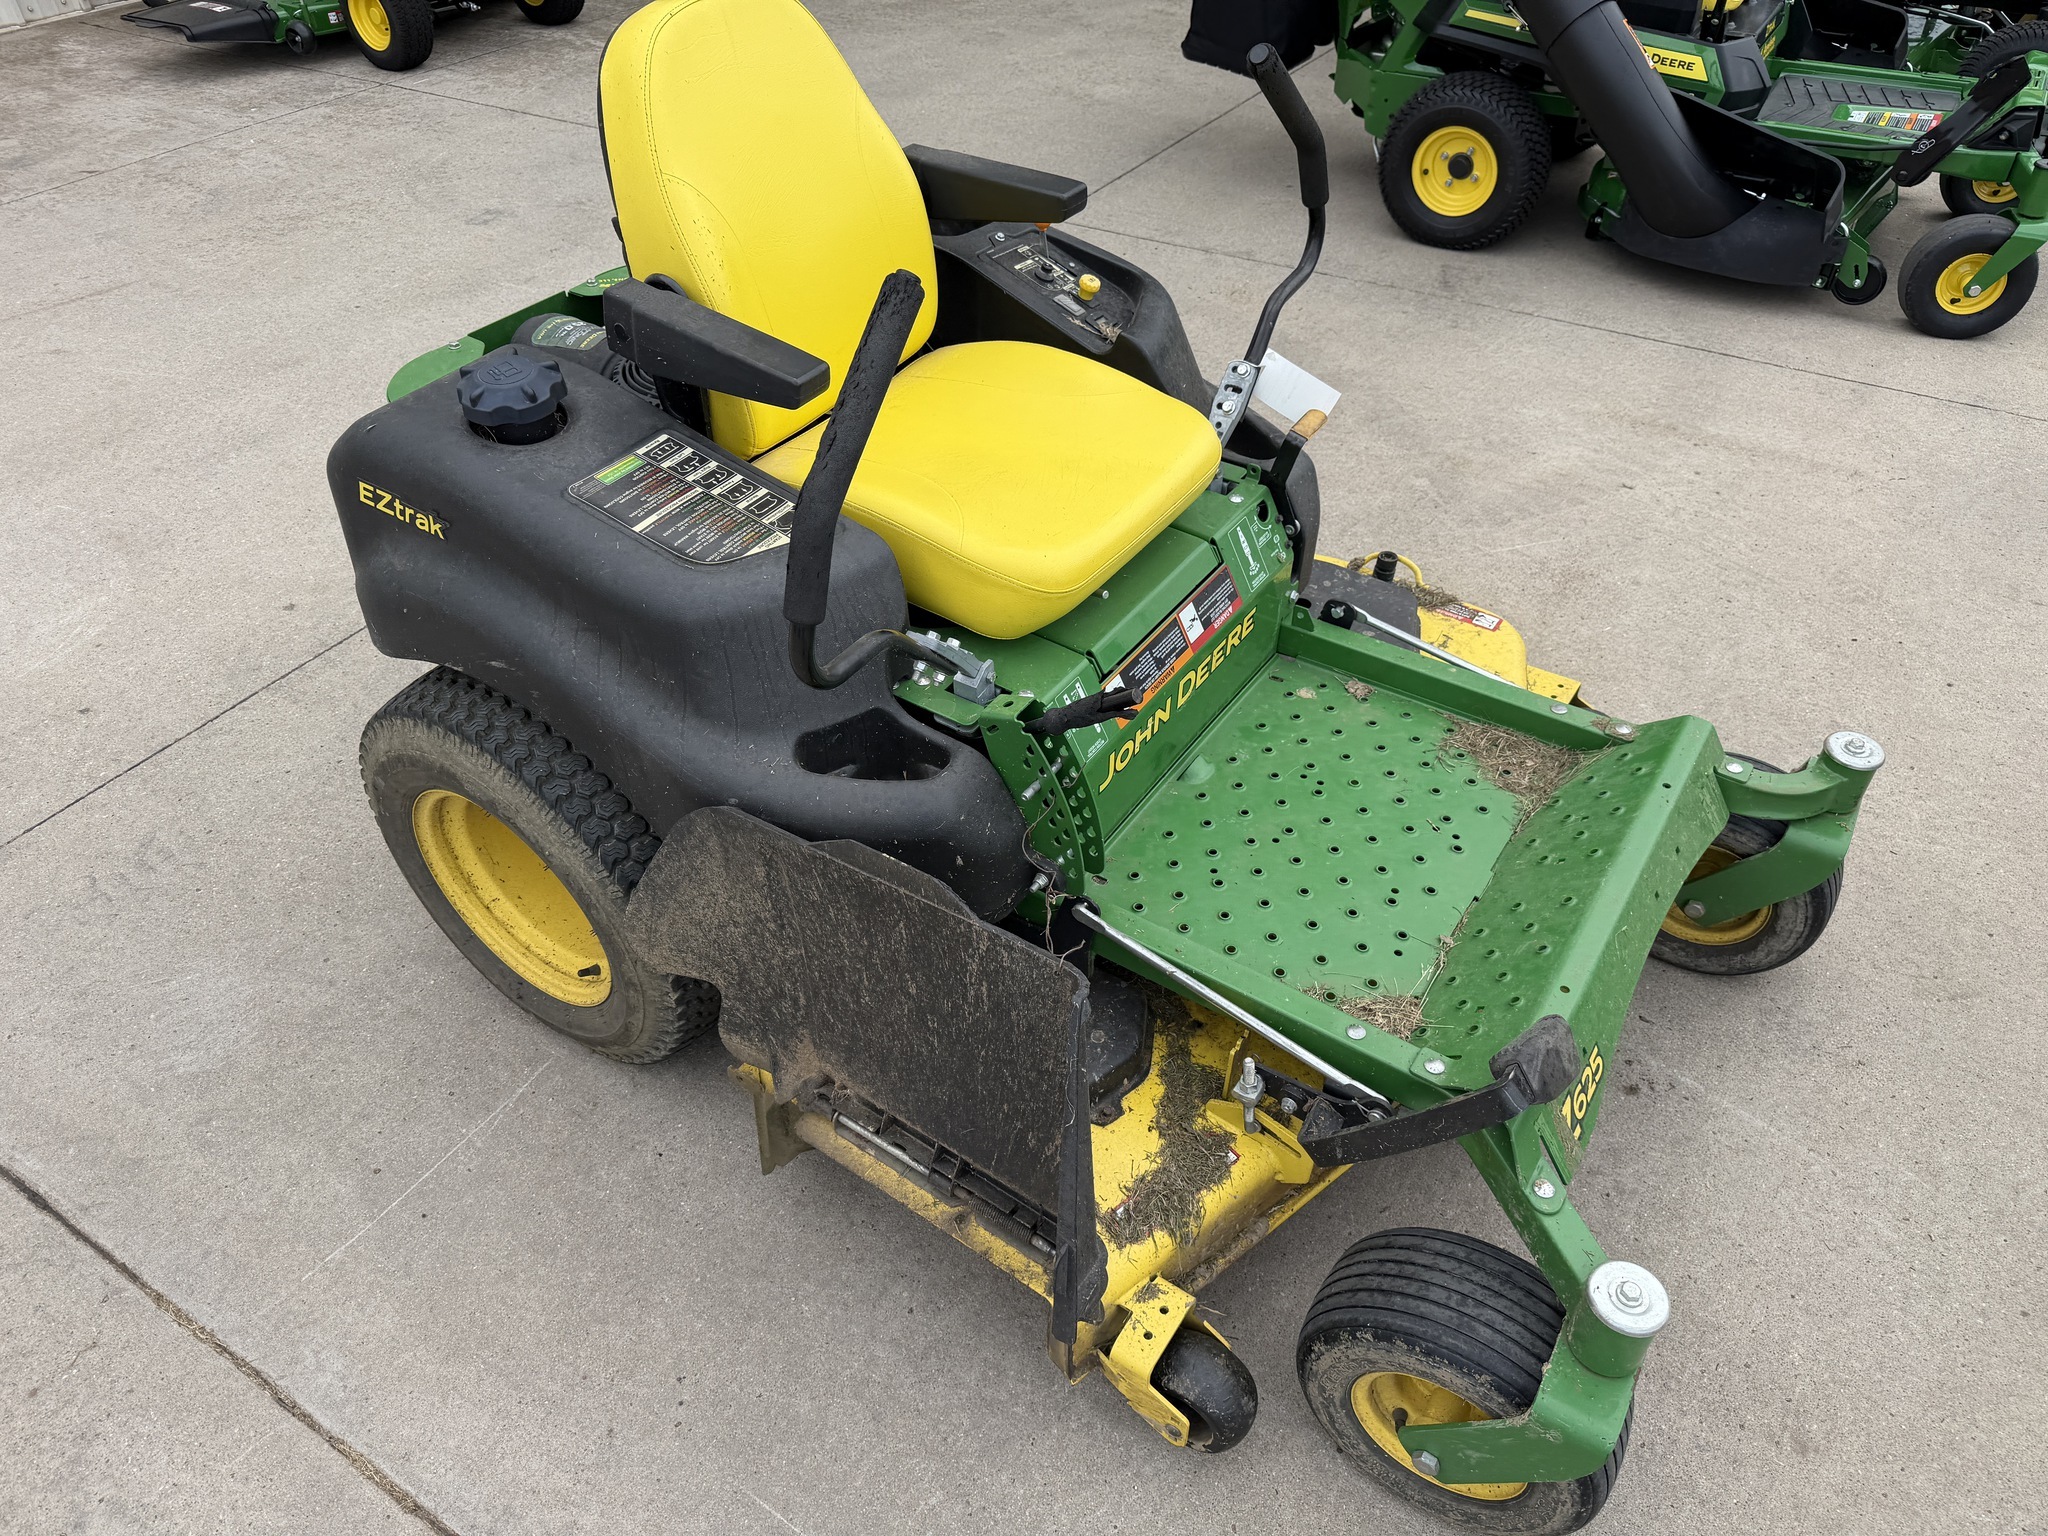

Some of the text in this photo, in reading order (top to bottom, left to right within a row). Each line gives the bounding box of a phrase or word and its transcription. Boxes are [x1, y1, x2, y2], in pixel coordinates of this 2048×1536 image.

[1651, 53, 1696, 71] DEERE
[358, 481, 444, 539] EZtrak
[1098, 696, 1172, 793] JOHN
[1176, 607, 1258, 710] DEERE
[1149, 667, 1173, 694] WARNING
